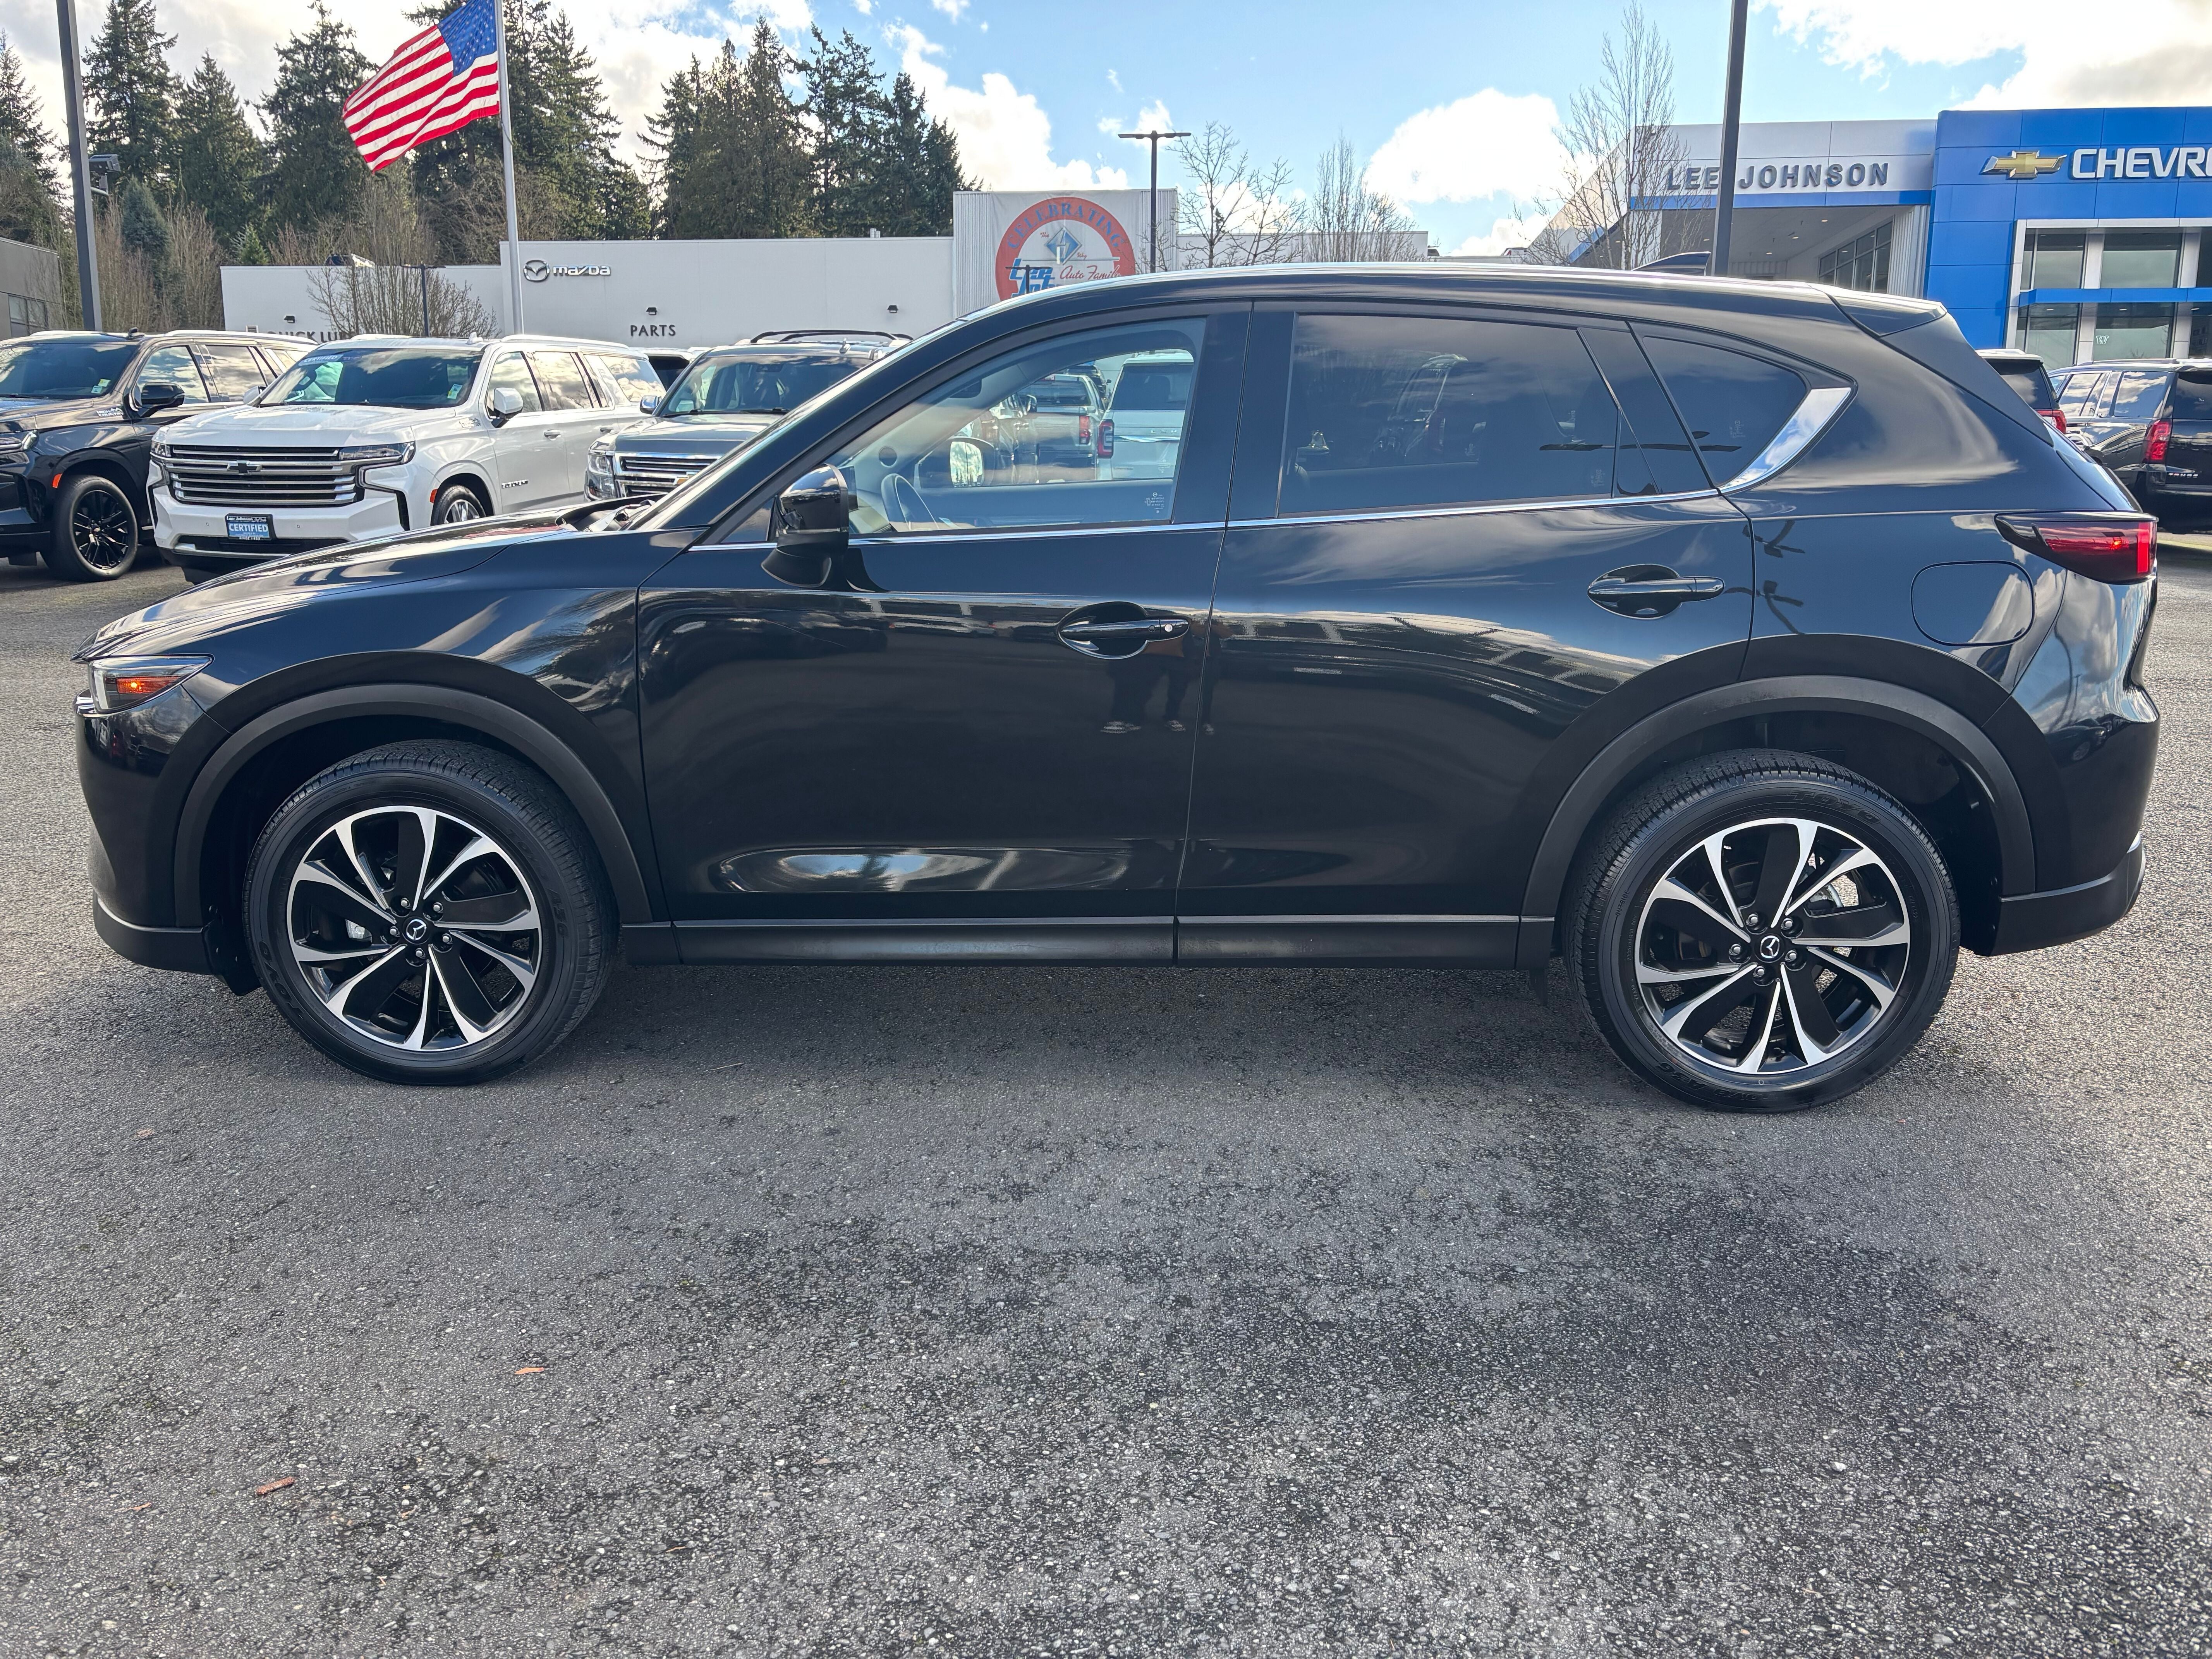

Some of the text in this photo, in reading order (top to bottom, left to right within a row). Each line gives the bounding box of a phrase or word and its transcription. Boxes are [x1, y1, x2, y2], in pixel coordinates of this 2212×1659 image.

[2072, 147, 2212, 178] CHEVR
[1667, 163, 1888, 191] LEE JOHNSON
[1007, 202, 1124, 248] CELEBRATING
[1060, 265, 1085, 279] Auto
[630, 325, 676, 337] PARTS
[229, 523, 268, 532] CERTIFIED
[1787, 790, 1881, 824] TOYO
